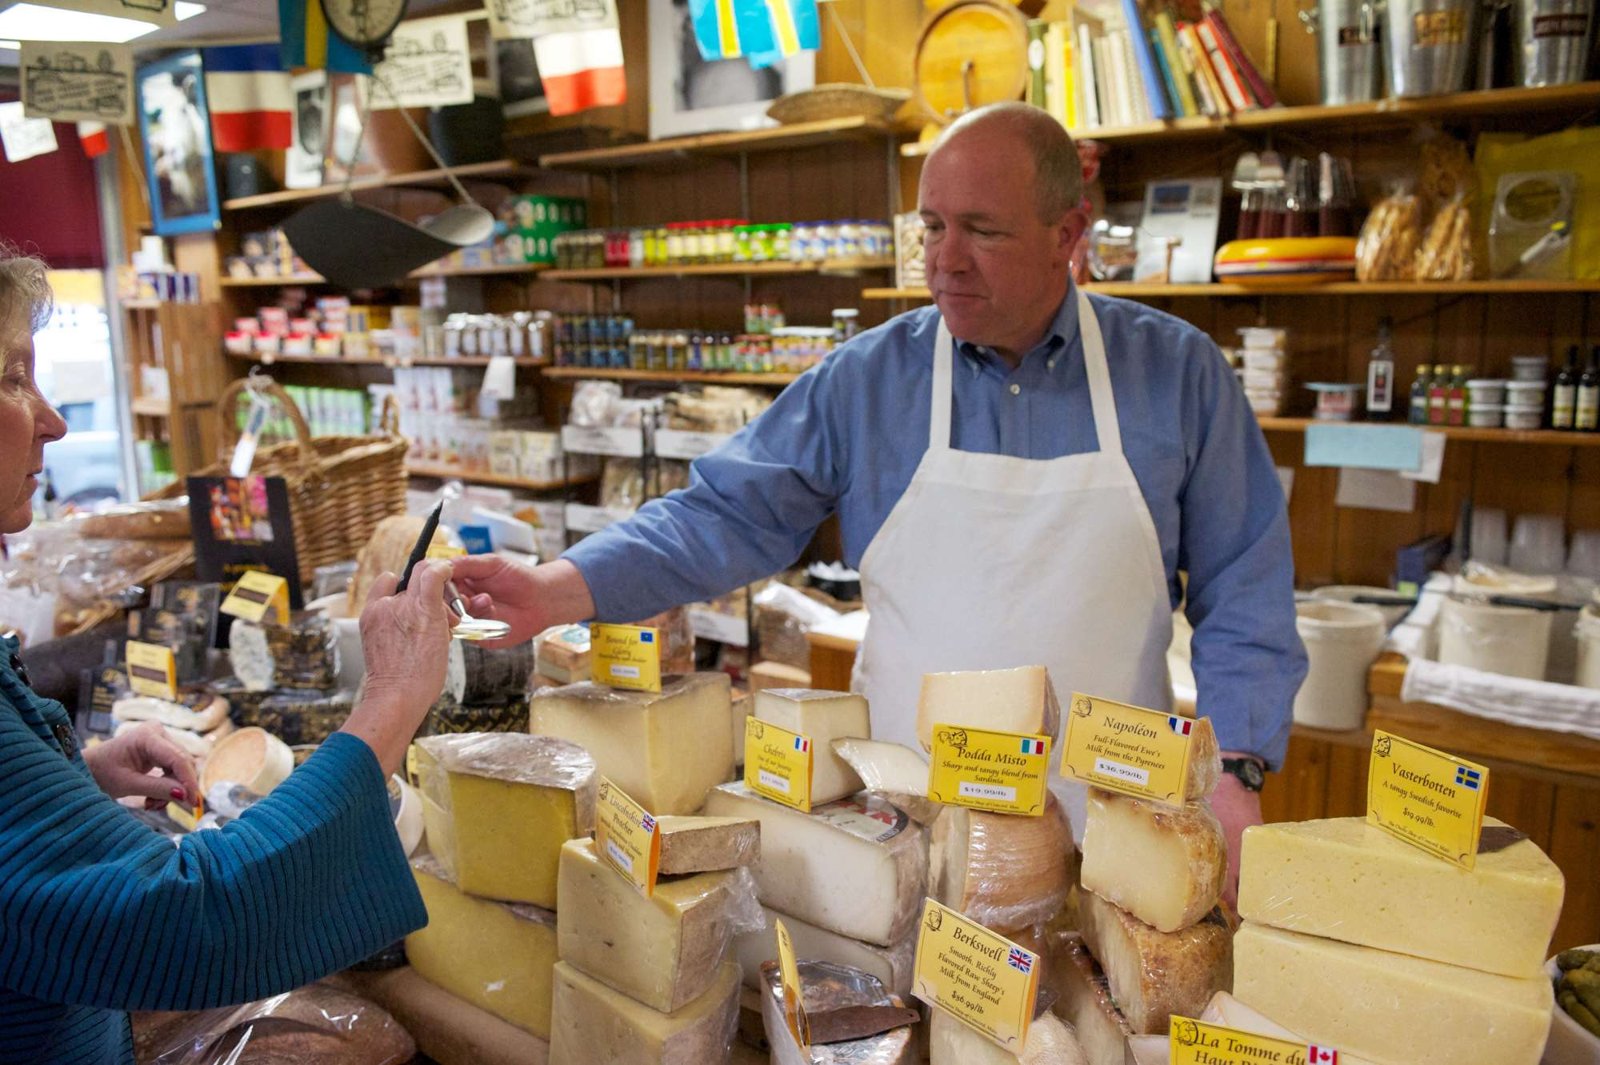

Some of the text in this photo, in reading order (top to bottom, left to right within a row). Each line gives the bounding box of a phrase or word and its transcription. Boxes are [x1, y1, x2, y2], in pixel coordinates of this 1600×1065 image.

[1103, 716, 1158, 739] Napoléon
[956, 746, 1027, 766] Podda Misto
[1085, 743, 1165, 770] Milk from the Pyrenees
[1093, 734, 1139, 752] Full-Flavored
[942, 760, 1038, 781] Sharp and tangy blend from
[974, 775, 1003, 784] Sardinia
[1392, 762, 1456, 798] Vasterbotten
[1389, 783, 1407, 799] tangy
[1408, 791, 1434, 807] Swedish
[1434, 802, 1462, 819] favorite
[953, 926, 1006, 962] Berkswell
[938, 953, 1005, 995] Flavored Raw Sheep's
[976, 961, 996, 979] Richly
[940, 967, 1000, 1005] Milk from England
[1201, 1033, 1219, 1048] La
[1226, 1037, 1280, 1062] Tomme
[1285, 1050, 1305, 1065] du
